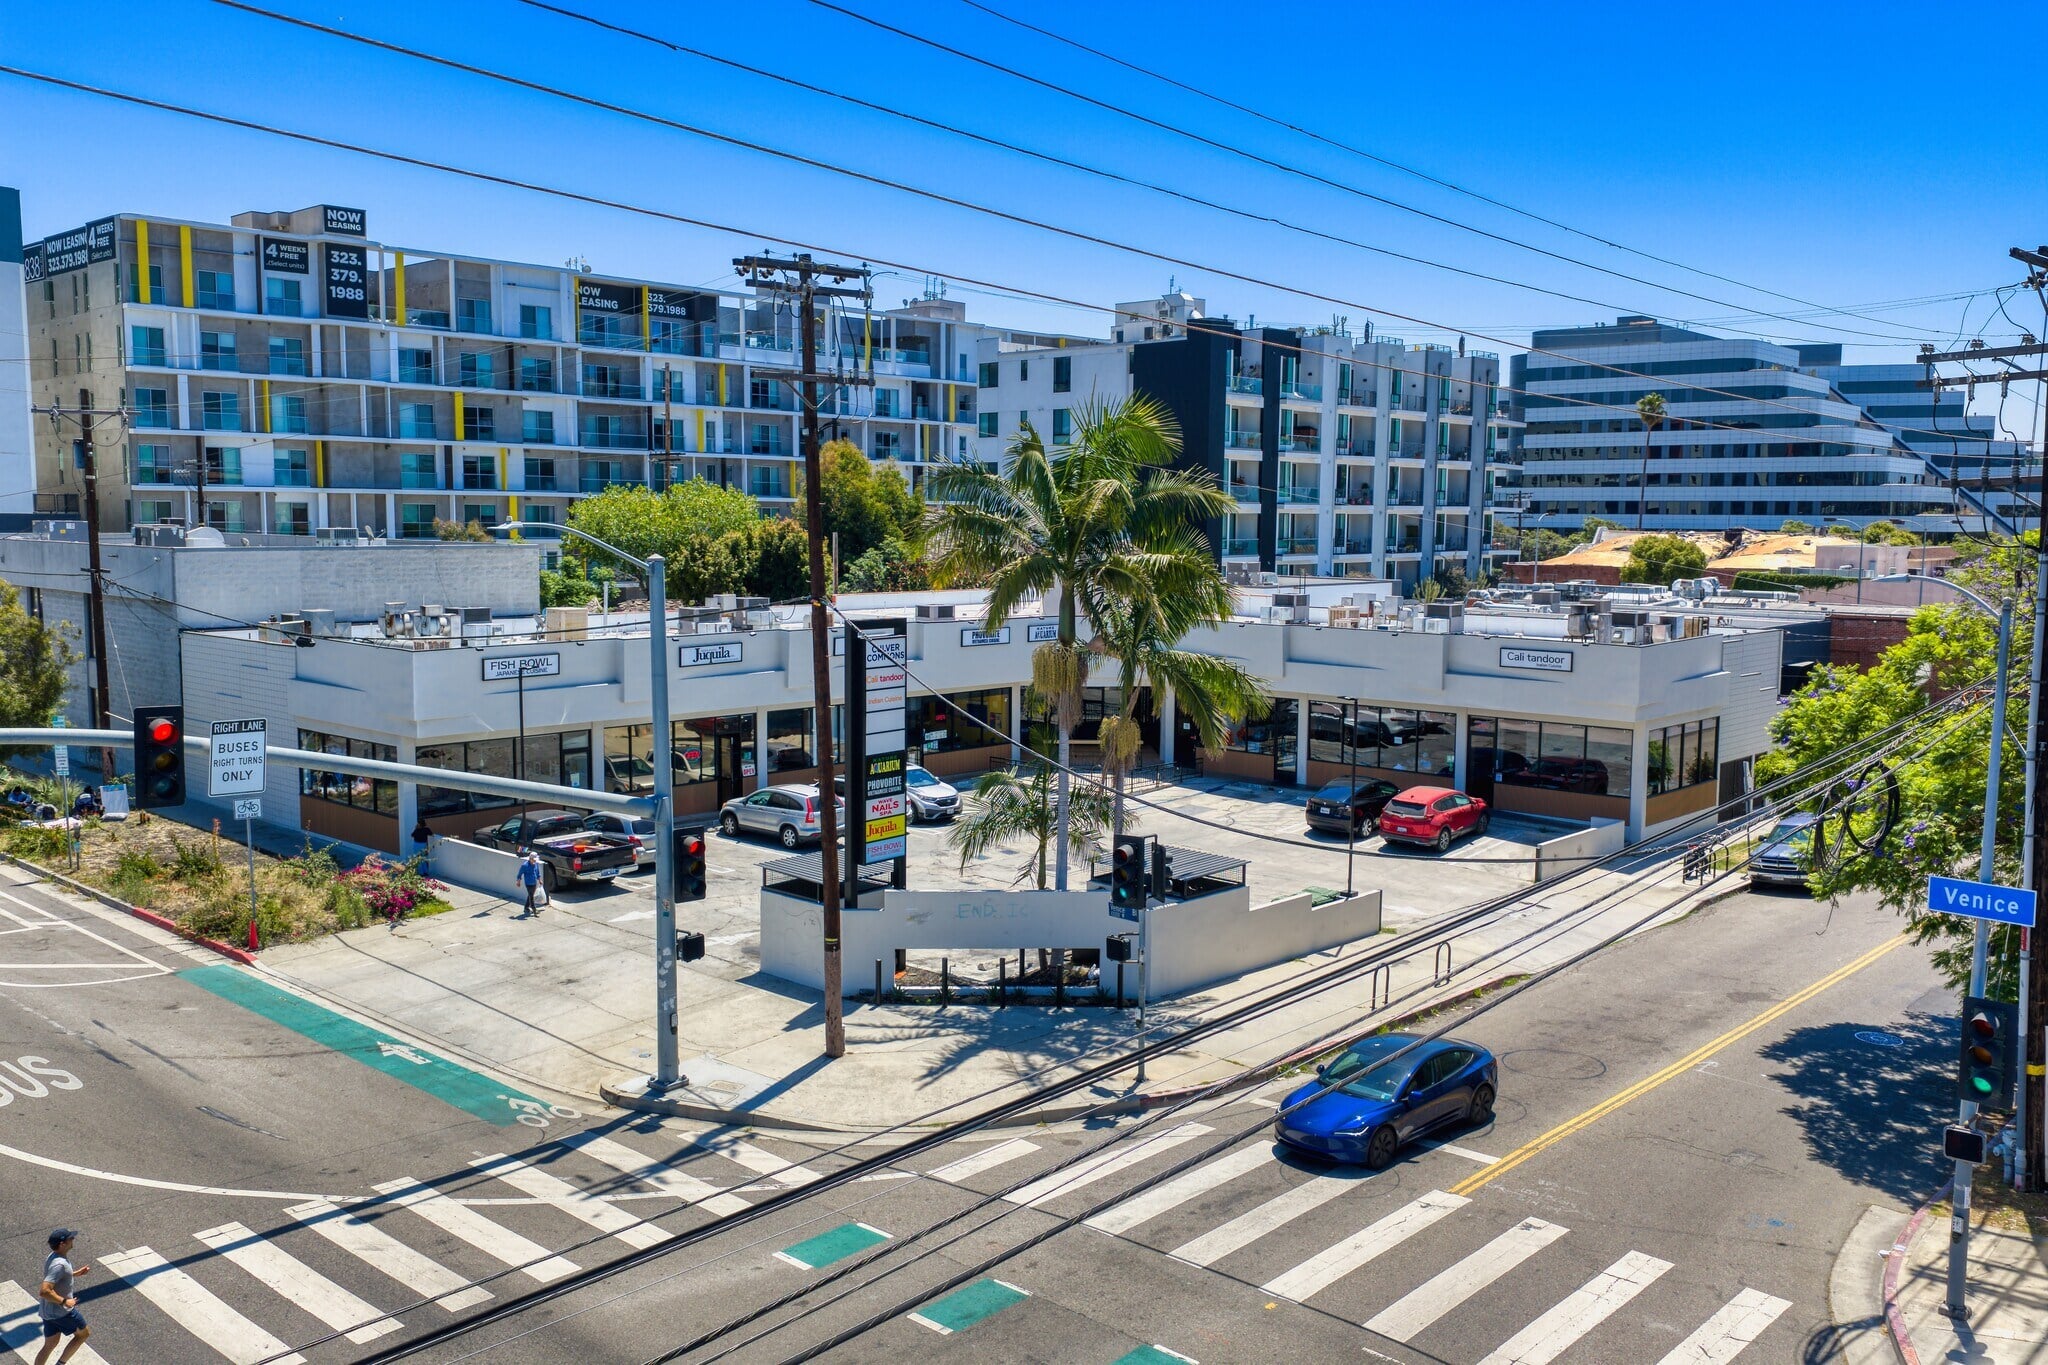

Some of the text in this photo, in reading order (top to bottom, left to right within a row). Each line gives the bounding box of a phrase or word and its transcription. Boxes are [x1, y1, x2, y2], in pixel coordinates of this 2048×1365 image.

[327, 209, 361, 223] NOW
[328, 221, 361, 231] LEASING
[89, 222, 113, 249] 4 WEEKS
[96, 236, 110, 248] FREE
[47, 239, 62, 254] NOW
[265, 243, 306, 258] 4 WEEKS
[280, 252, 299, 260] FREE
[330, 250, 362, 266] 323.
[25, 256, 40, 280] 838
[330, 268, 362, 284] 379.
[329, 286, 364, 301] 1988
[578, 285, 601, 296] NOW
[578, 296, 619, 309] EASING
[648, 292, 666, 303] 323.
[648, 303, 686, 316] 379.1988
[693, 646, 730, 664] Juquila
[1507, 651, 1565, 664] Cali tandoor
[490, 657, 552, 670] FISH BOWL
[866, 673, 904, 684] Cali tandoor
[214, 720, 264, 733] RIGHT LANE
[218, 741, 259, 754] BUSES
[213, 756, 263, 767] RIGHT TURNS
[870, 759, 900, 775] AQUARIUM
[222, 770, 253, 782] ONLY
[868, 776, 902, 790] PHOVORITE
[872, 801, 899, 813] NAILS
[866, 821, 897, 837] Juquila
[868, 845, 882, 853] FISH
[884, 841, 903, 850] BOWL
[1944, 886, 2020, 915] Venice
